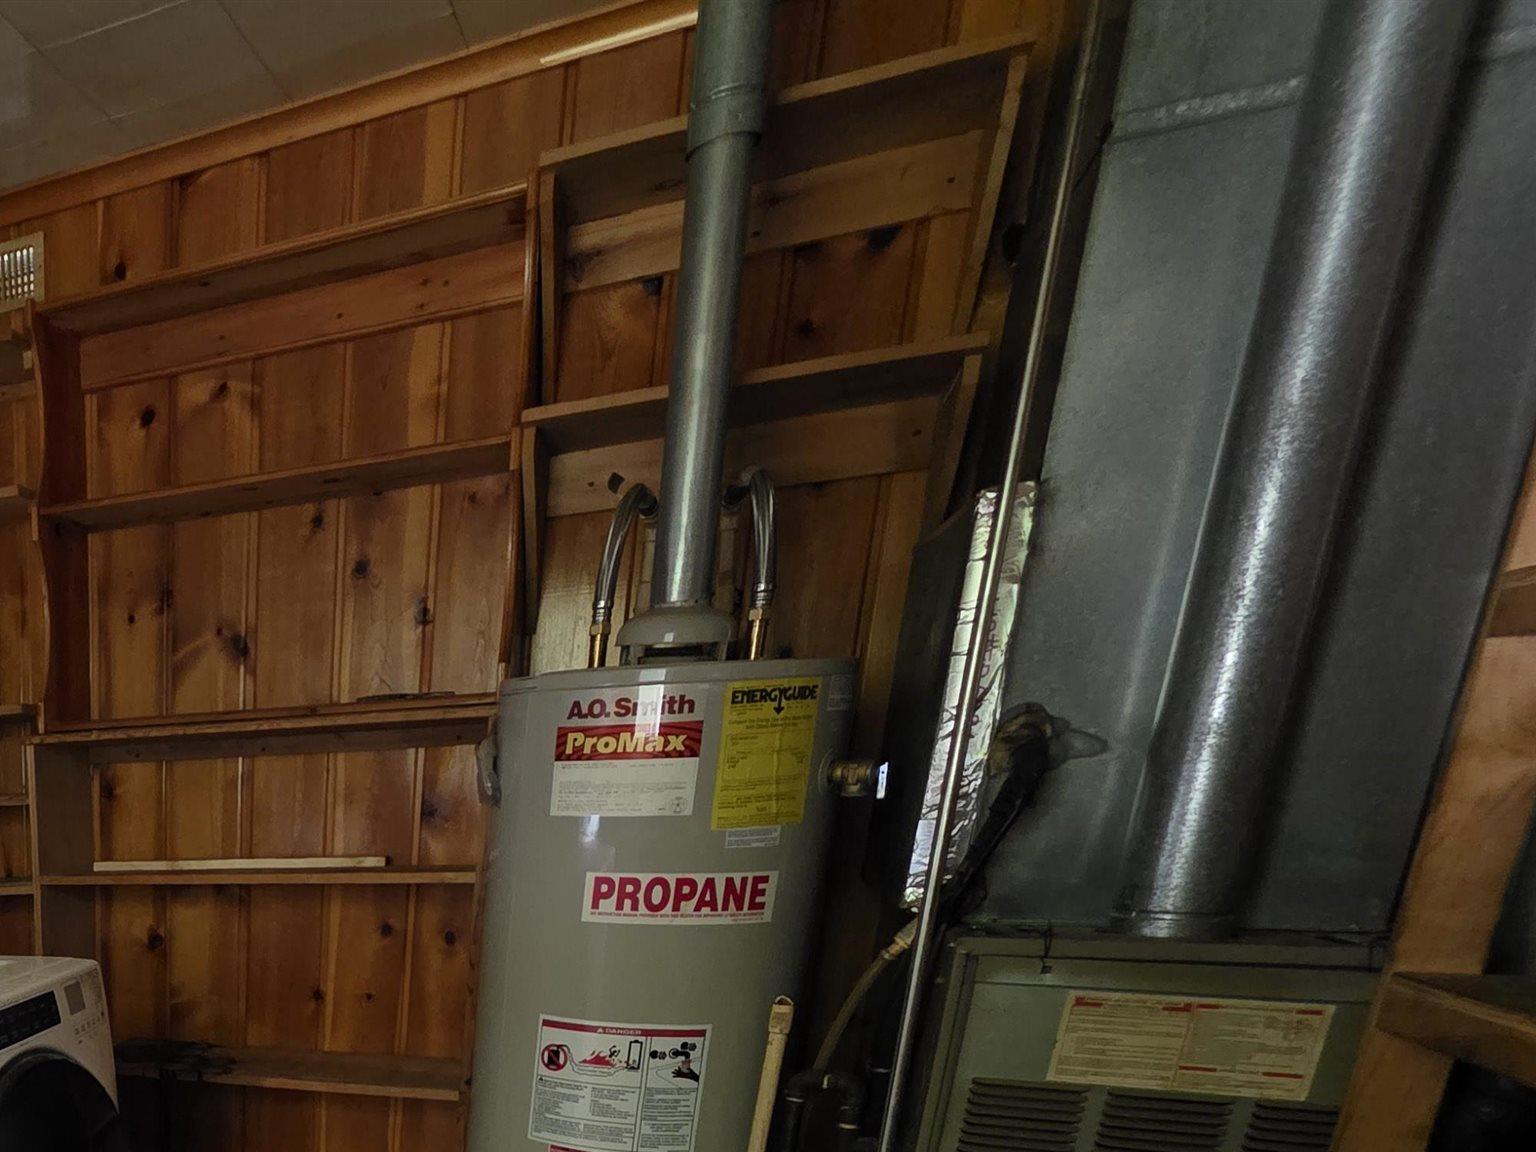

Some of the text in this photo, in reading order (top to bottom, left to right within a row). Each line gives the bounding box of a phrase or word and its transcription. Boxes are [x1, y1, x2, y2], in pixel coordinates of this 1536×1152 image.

[567, 694, 696, 719] A.O. Smith
[565, 731, 688, 755] ProMax
[590, 875, 770, 913] PROPANE
